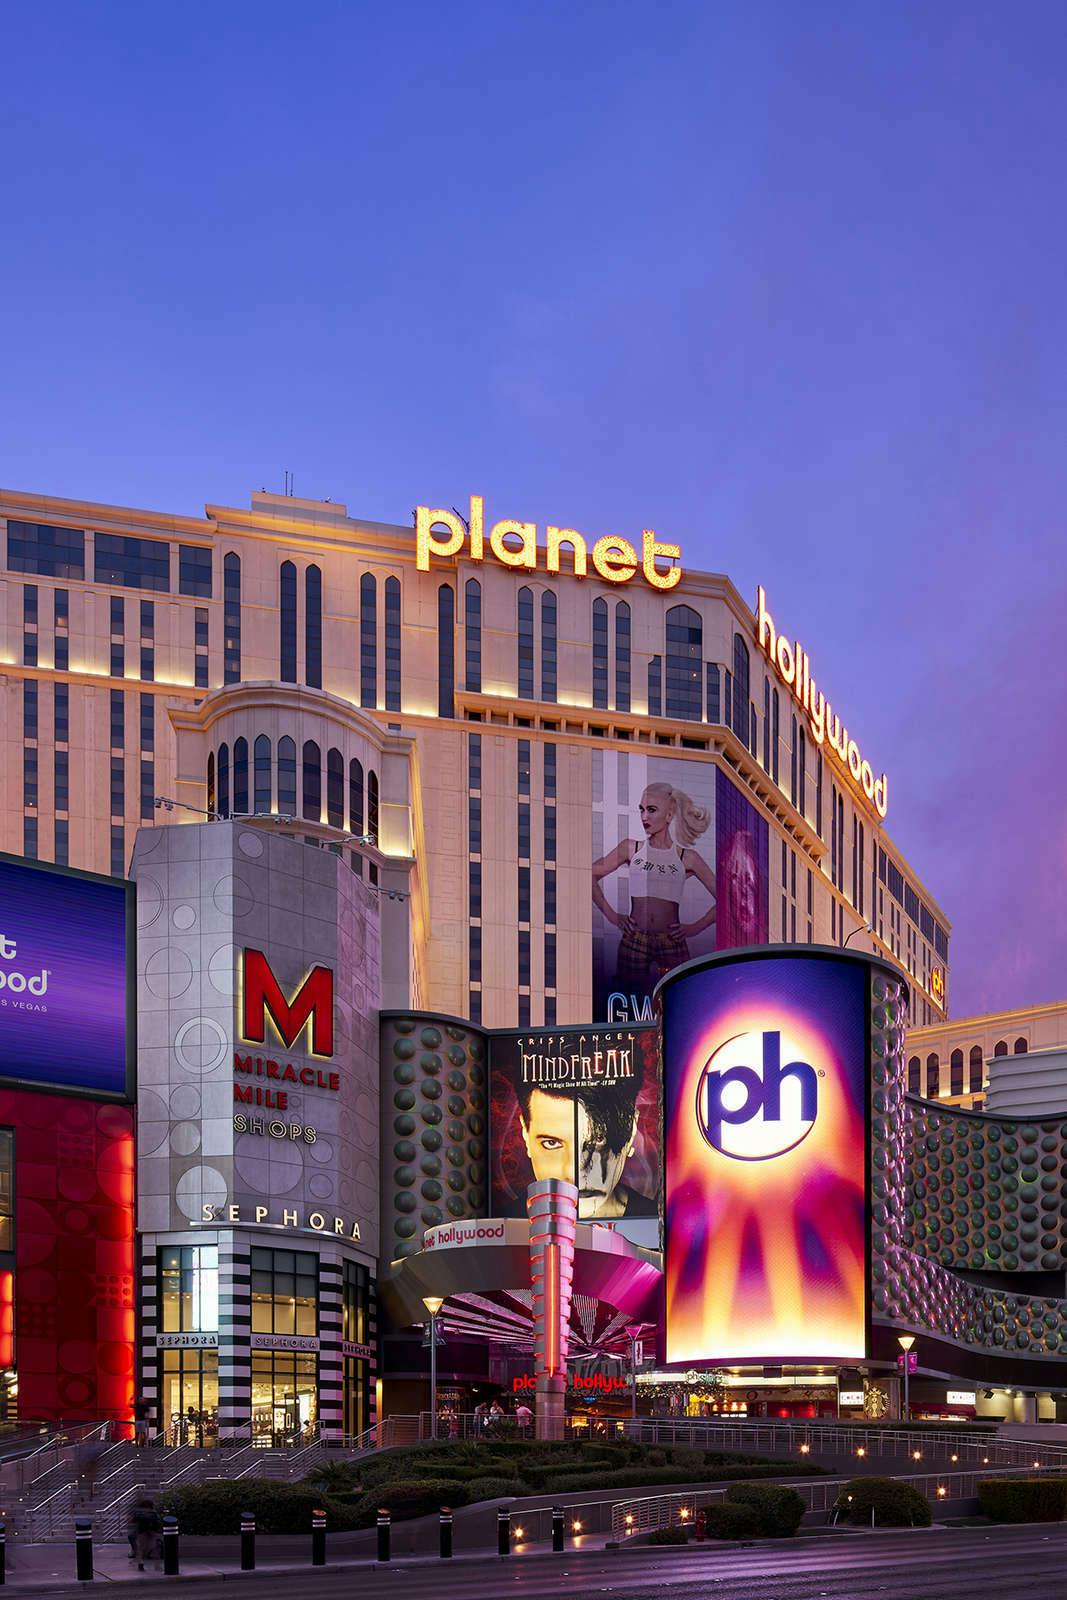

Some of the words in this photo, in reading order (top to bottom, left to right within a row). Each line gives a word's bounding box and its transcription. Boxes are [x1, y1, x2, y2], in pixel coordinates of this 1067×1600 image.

[416, 495, 682, 590] planet
[757, 585, 888, 818] hollywood
[12, 1001, 48, 1013] VEGAS
[517, 1036, 565, 1046] CRISS
[580, 1032, 635, 1042] ANGEL
[233, 1052, 340, 1092] MIRACLE
[233, 1083, 289, 1111] MILE
[233, 1113, 317, 1144] SHOPS
[202, 1203, 362, 1240] SEPHORA
[438, 1223, 505, 1244] hollywood
[158, 1335, 217, 1346] SEPHORA
[255, 1336, 318, 1349] SEPHORA
